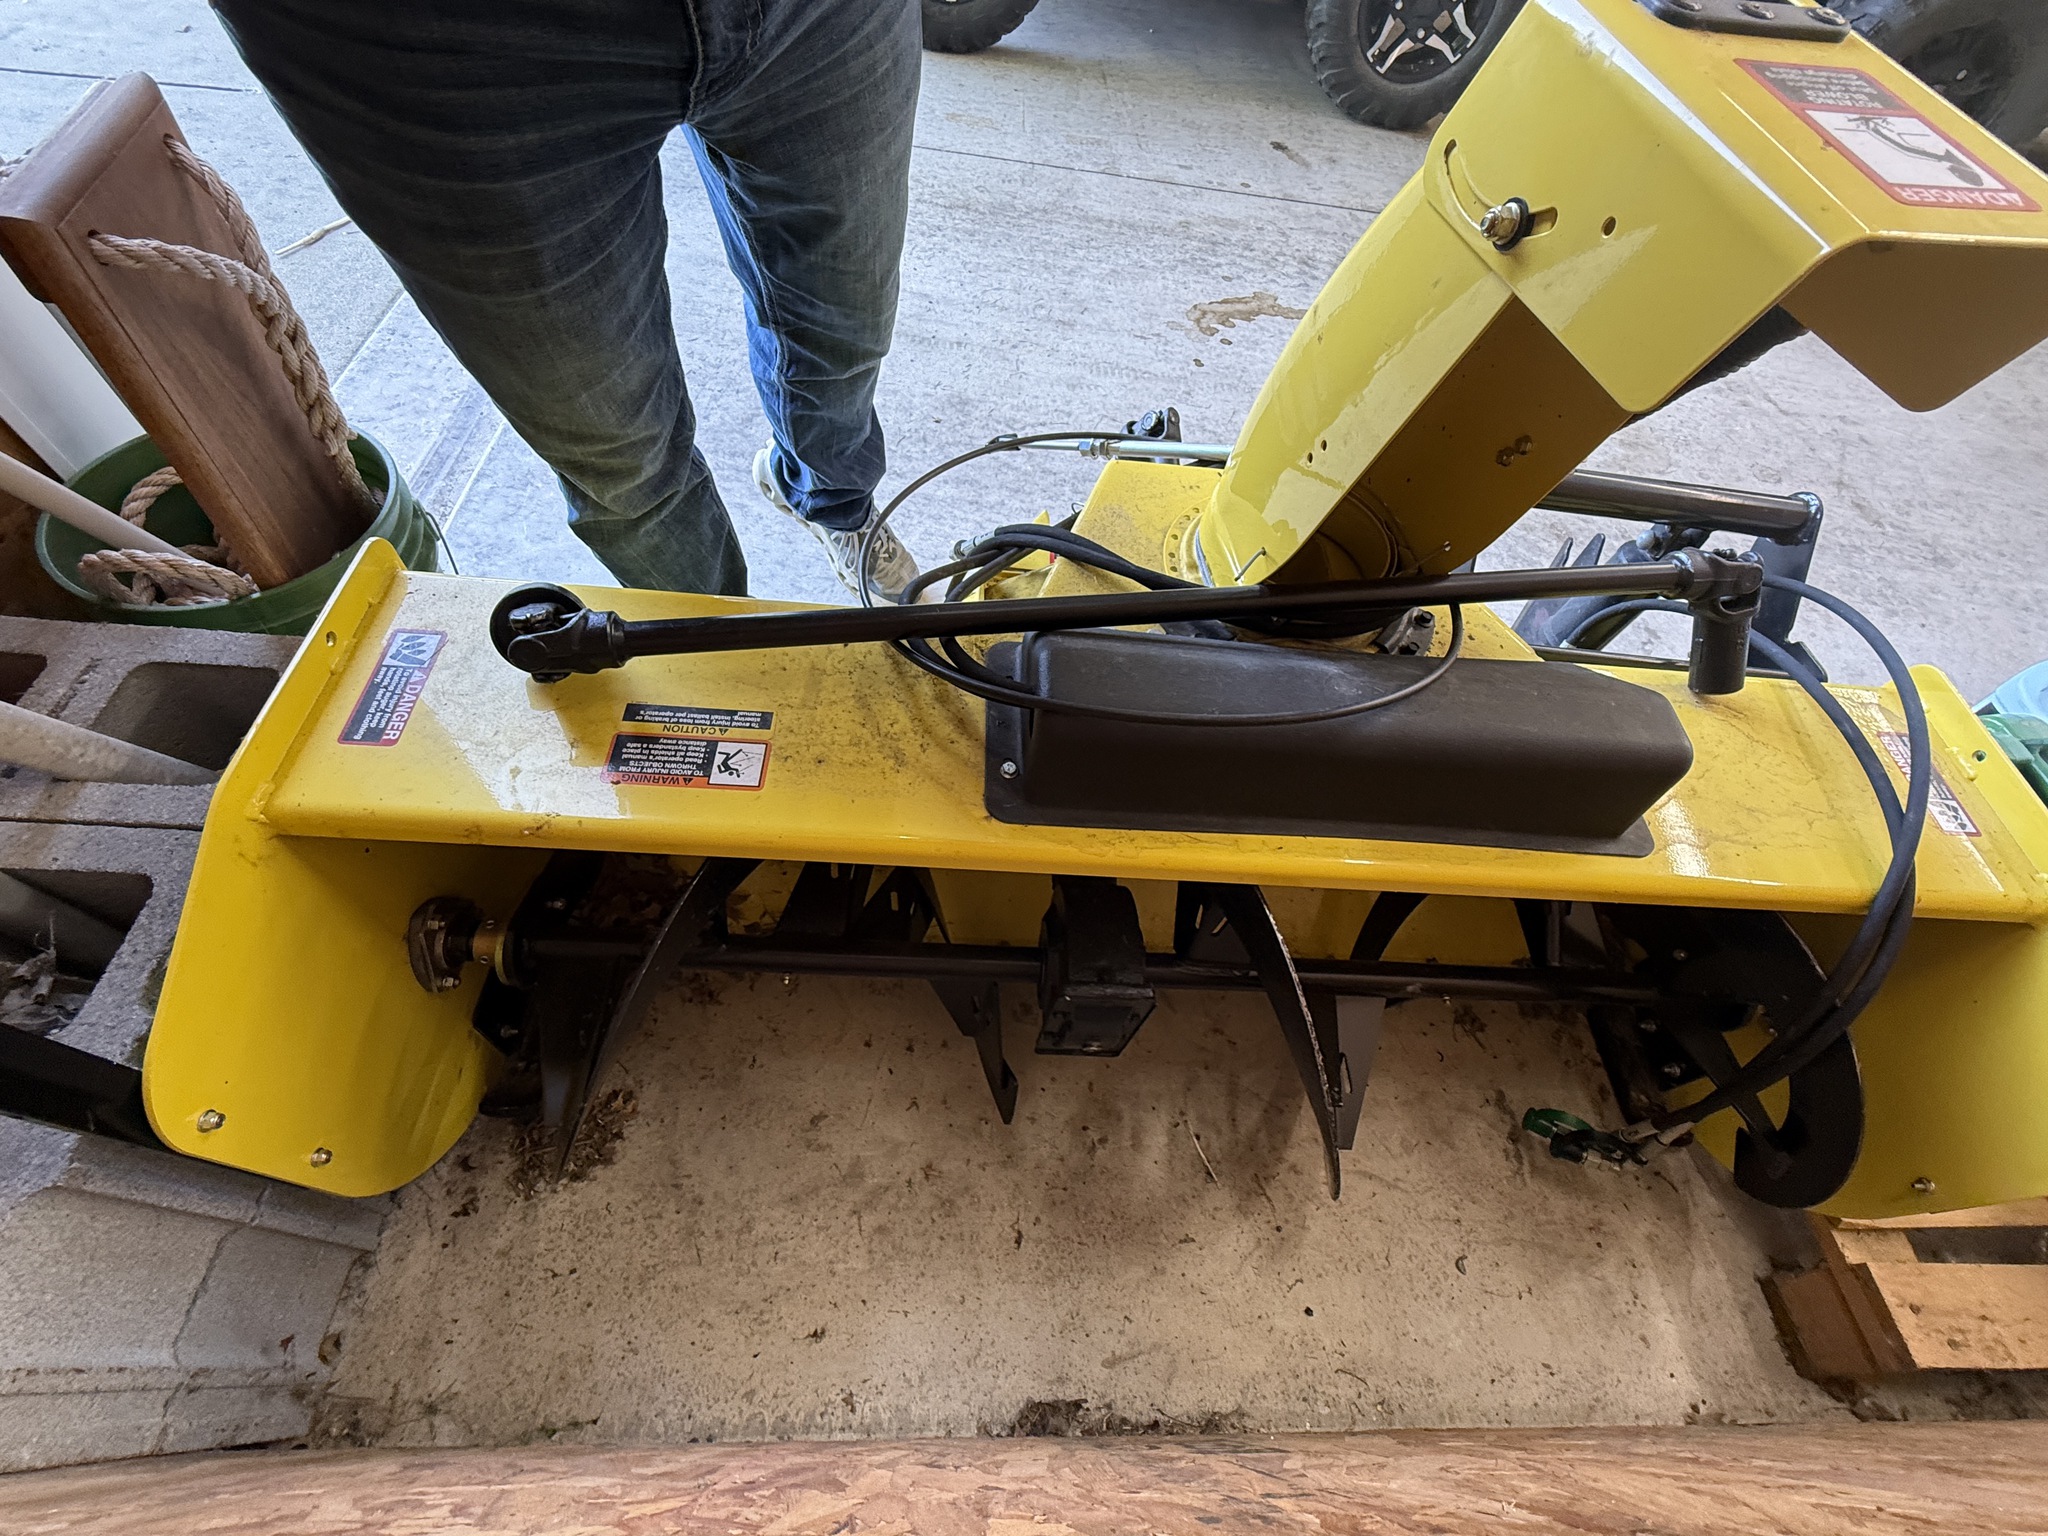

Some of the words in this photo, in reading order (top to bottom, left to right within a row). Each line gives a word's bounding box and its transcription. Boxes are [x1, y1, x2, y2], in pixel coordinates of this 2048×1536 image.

[1803, 90, 1868, 101] BLOWER
[1807, 97, 1883, 109] ROTATING
[1896, 187, 2007, 204] DANGER
[374, 667, 387, 684] away.
[380, 667, 396, 687] hands,
[388, 668, 403, 691] rotating
[395, 677, 407, 694] avoid
[375, 688, 386, 700] feet
[377, 692, 392, 711] auger,
[368, 701, 379, 712] and
[385, 695, 400, 712] injury
[370, 712, 383, 727] keep
[382, 685, 421, 739] DANGER
[644, 715, 669, 723] braking
[353, 714, 372, 739] clothing
[379, 713, 391, 728] from
[662, 725, 716, 734] CAUTION
[621, 774, 680, 784] WARNING
